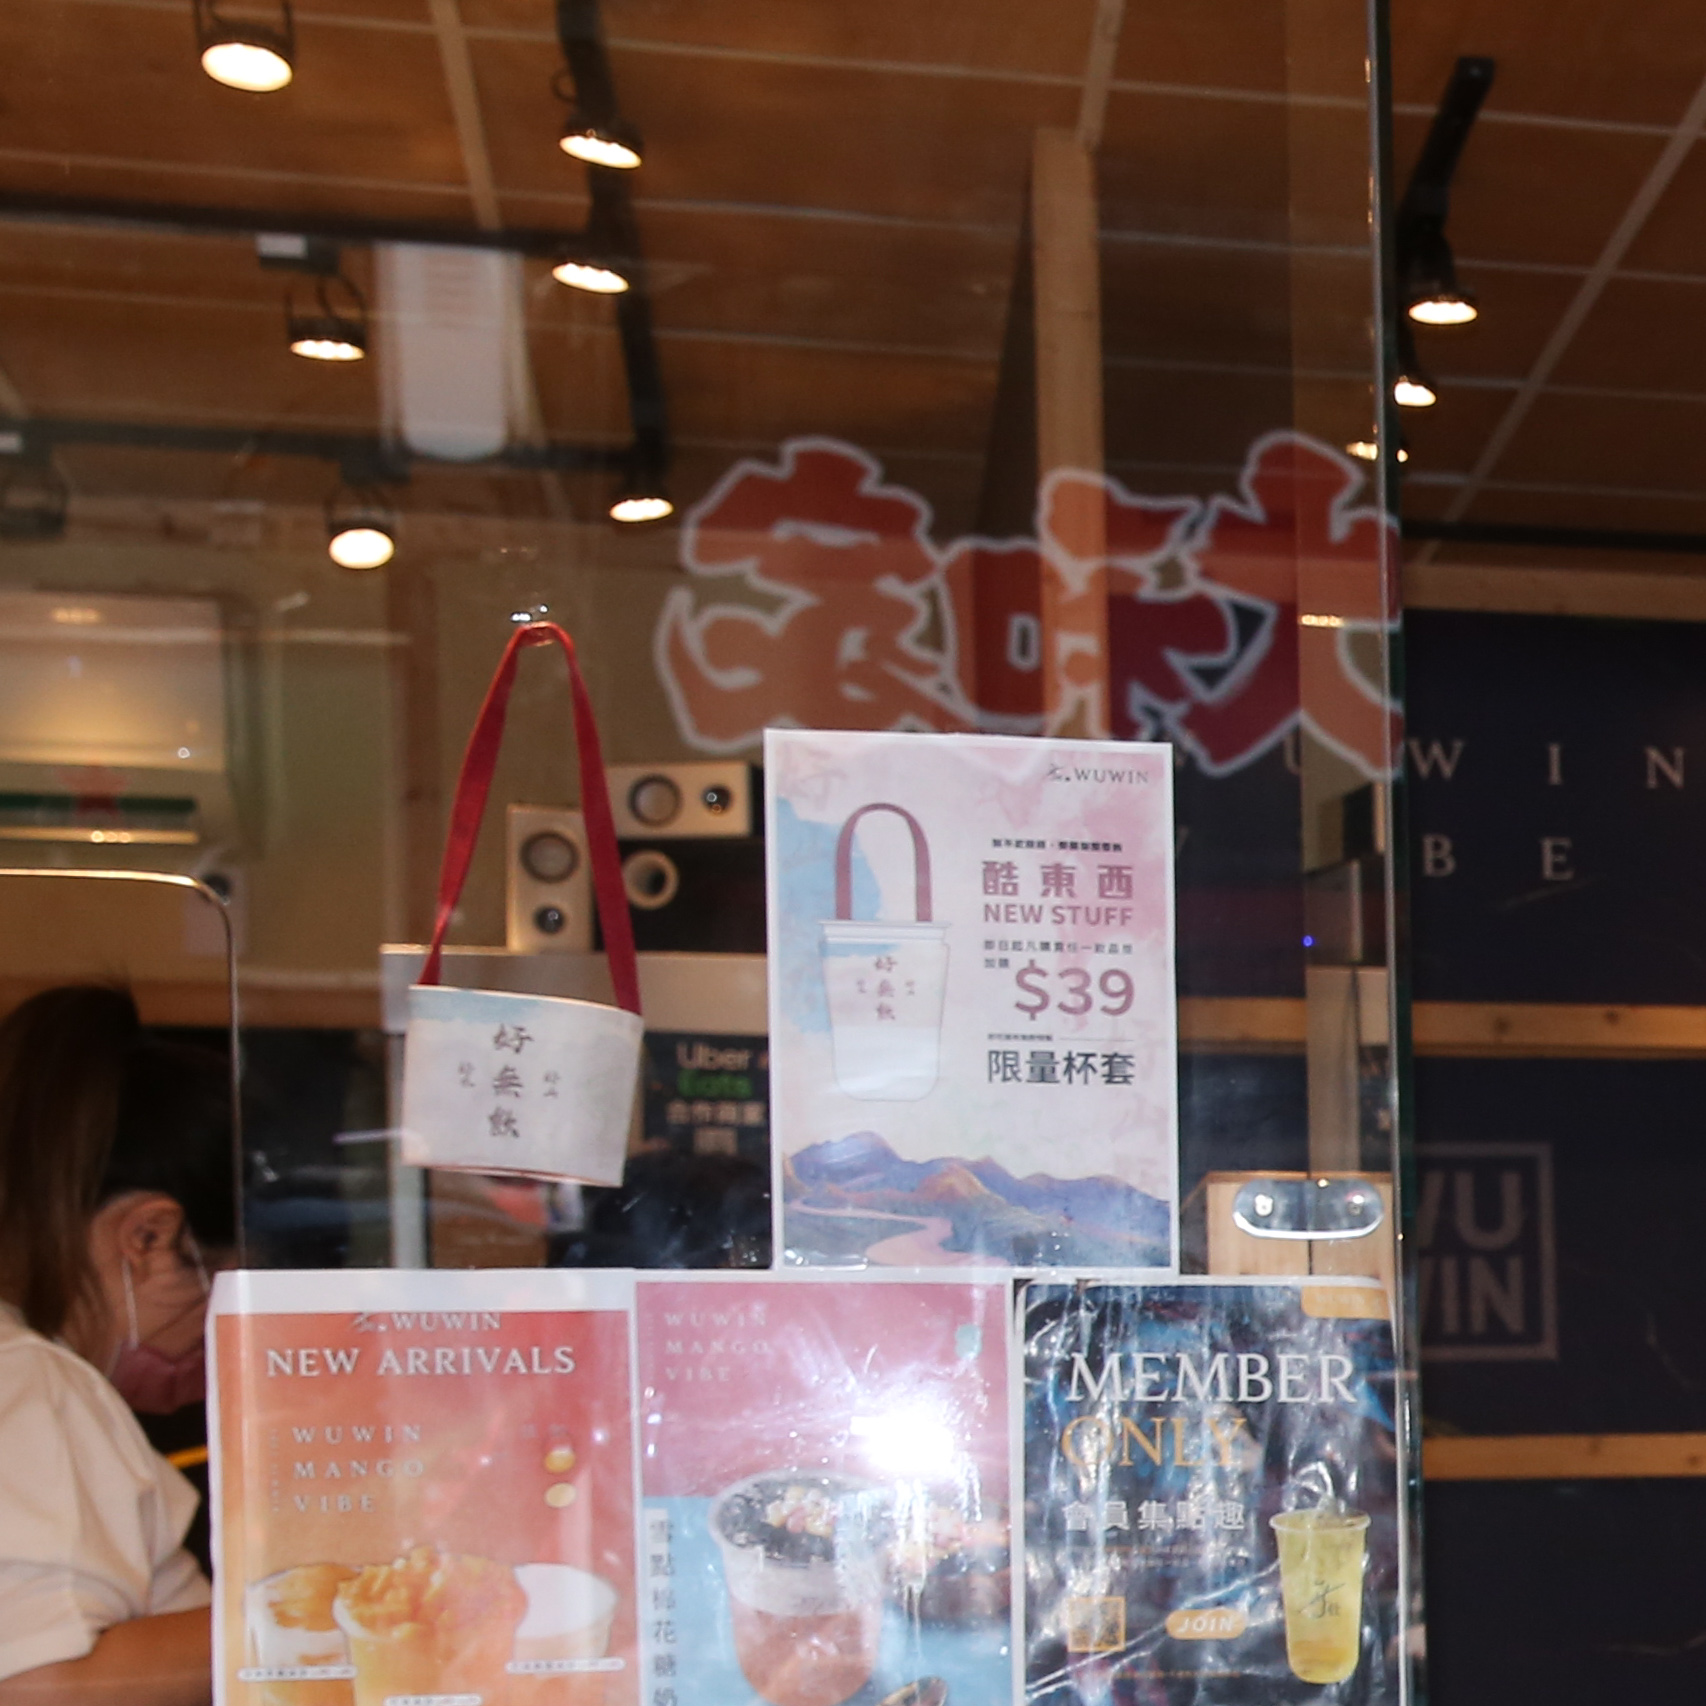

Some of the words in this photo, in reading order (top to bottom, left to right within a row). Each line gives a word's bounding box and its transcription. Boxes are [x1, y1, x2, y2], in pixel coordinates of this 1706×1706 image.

[1073, 767, 1149, 784] WUWIN
[982, 860, 1134, 900] 酷東西
[984, 903, 1043, 924] NEW
[1051, 905, 1133, 927] STUFF
[1014, 958, 1135, 1022] $39
[487, 1022, 535, 1138] 好無飲
[988, 1050, 1135, 1085] 限量杯套
[391, 1311, 500, 1331] WUWIN
[267, 1348, 360, 1377] NEW
[377, 1346, 577, 1376] ARRIVALS
[1065, 1351, 1357, 1403] MEMBER
[292, 1425, 422, 1445] WUWIN
[1061, 1415, 1248, 1468] ONLY
[294, 1458, 425, 1480] MANGO
[294, 1494, 375, 1513] VIBE
[1177, 1615, 1235, 1633] JOIN
